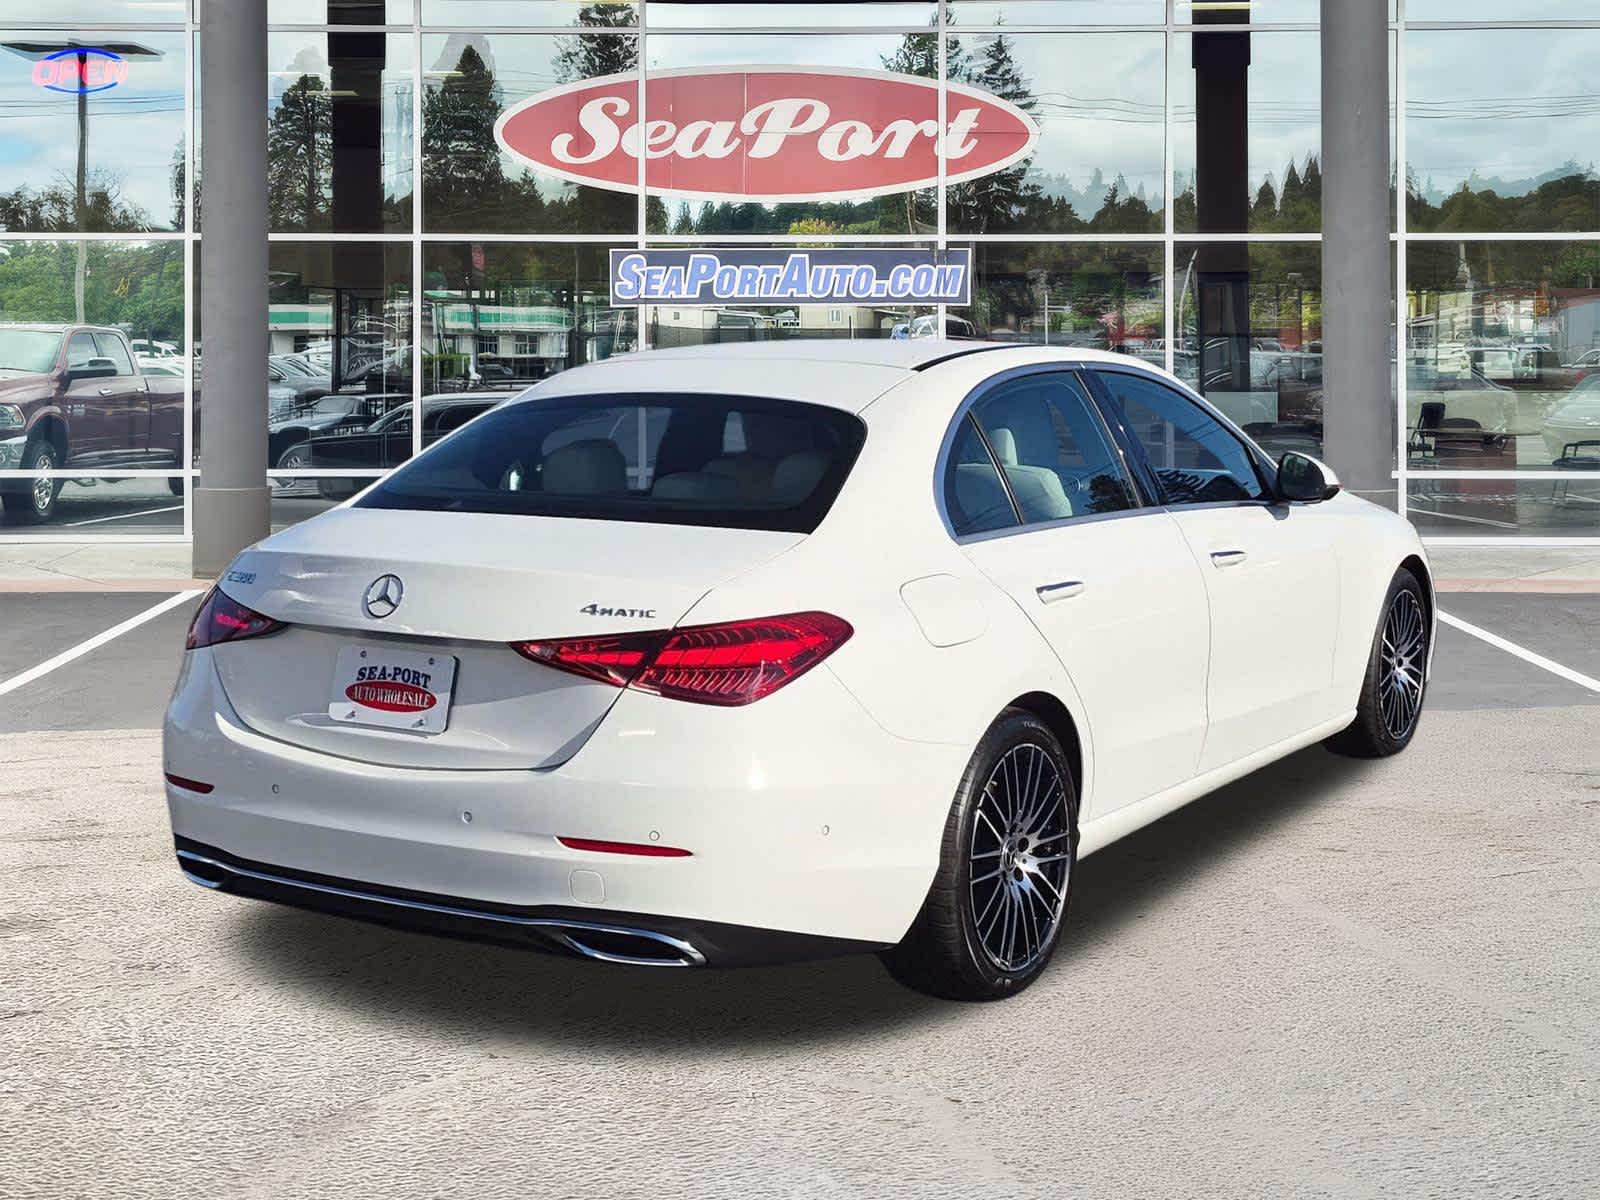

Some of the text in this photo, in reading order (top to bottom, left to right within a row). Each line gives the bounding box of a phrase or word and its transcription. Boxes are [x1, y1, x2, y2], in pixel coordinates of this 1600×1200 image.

[32, 59, 128, 85] OPEN
[551, 96, 982, 165] SeaPort
[580, 603, 656, 618] 4MATIC
[356, 666, 432, 688] SEA-PORT
